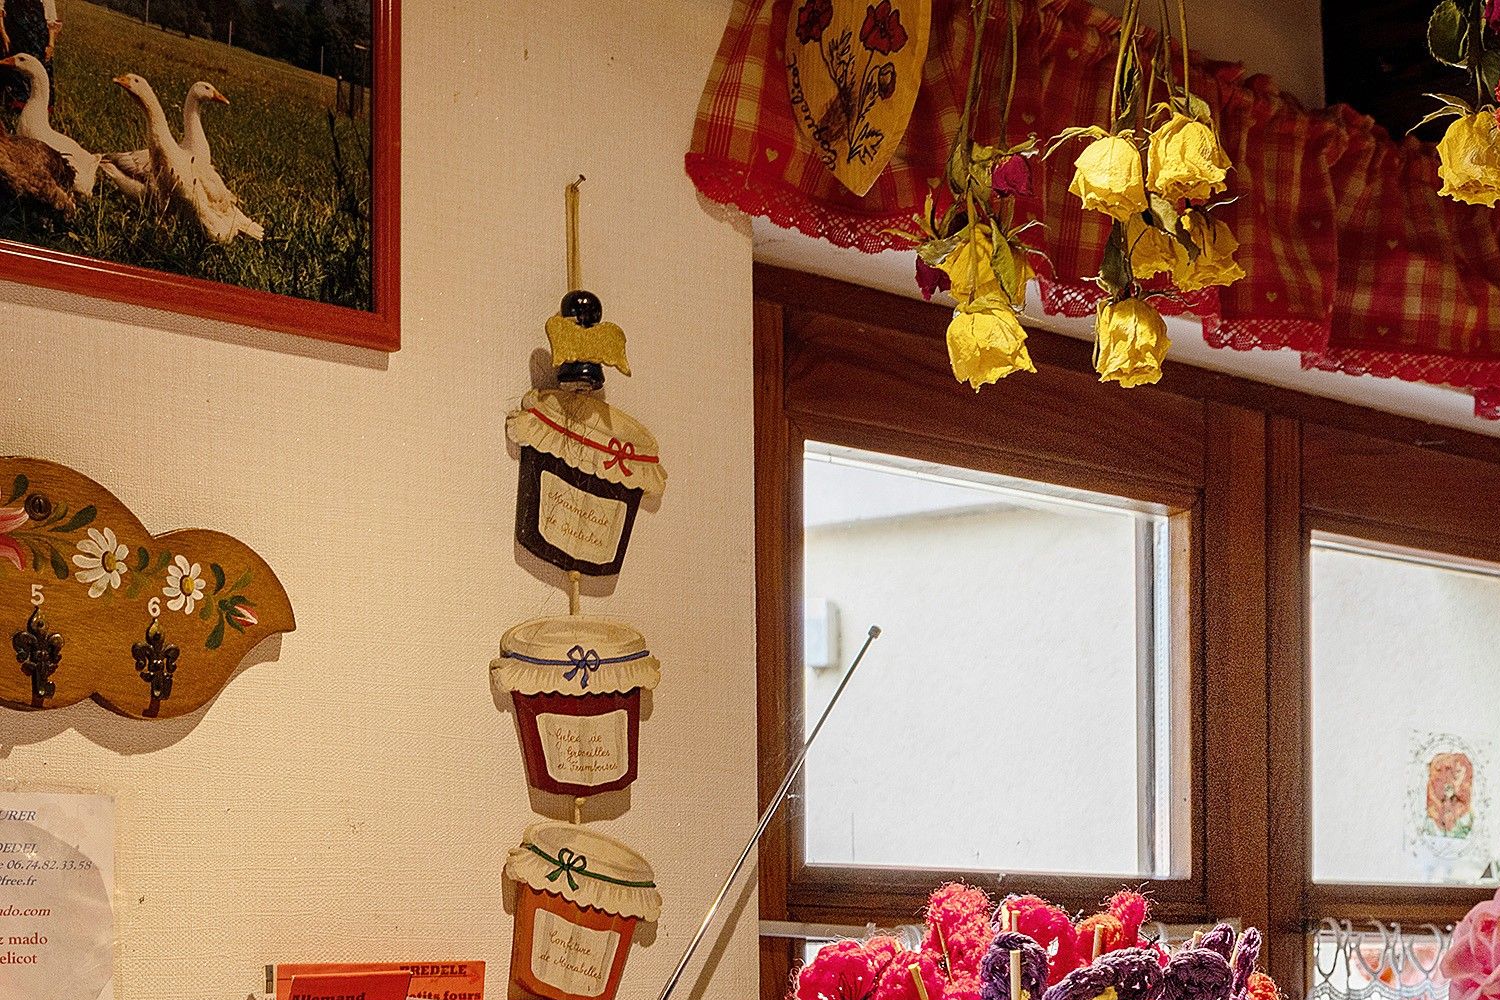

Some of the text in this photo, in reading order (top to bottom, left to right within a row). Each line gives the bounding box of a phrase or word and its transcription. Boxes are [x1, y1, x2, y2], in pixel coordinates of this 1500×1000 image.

[31, 584, 45, 605] 5
[148, 596, 160, 618] 6
[6, 859, 92, 871] 06.74.82.33.58
[8, 933, 48, 945] mado
